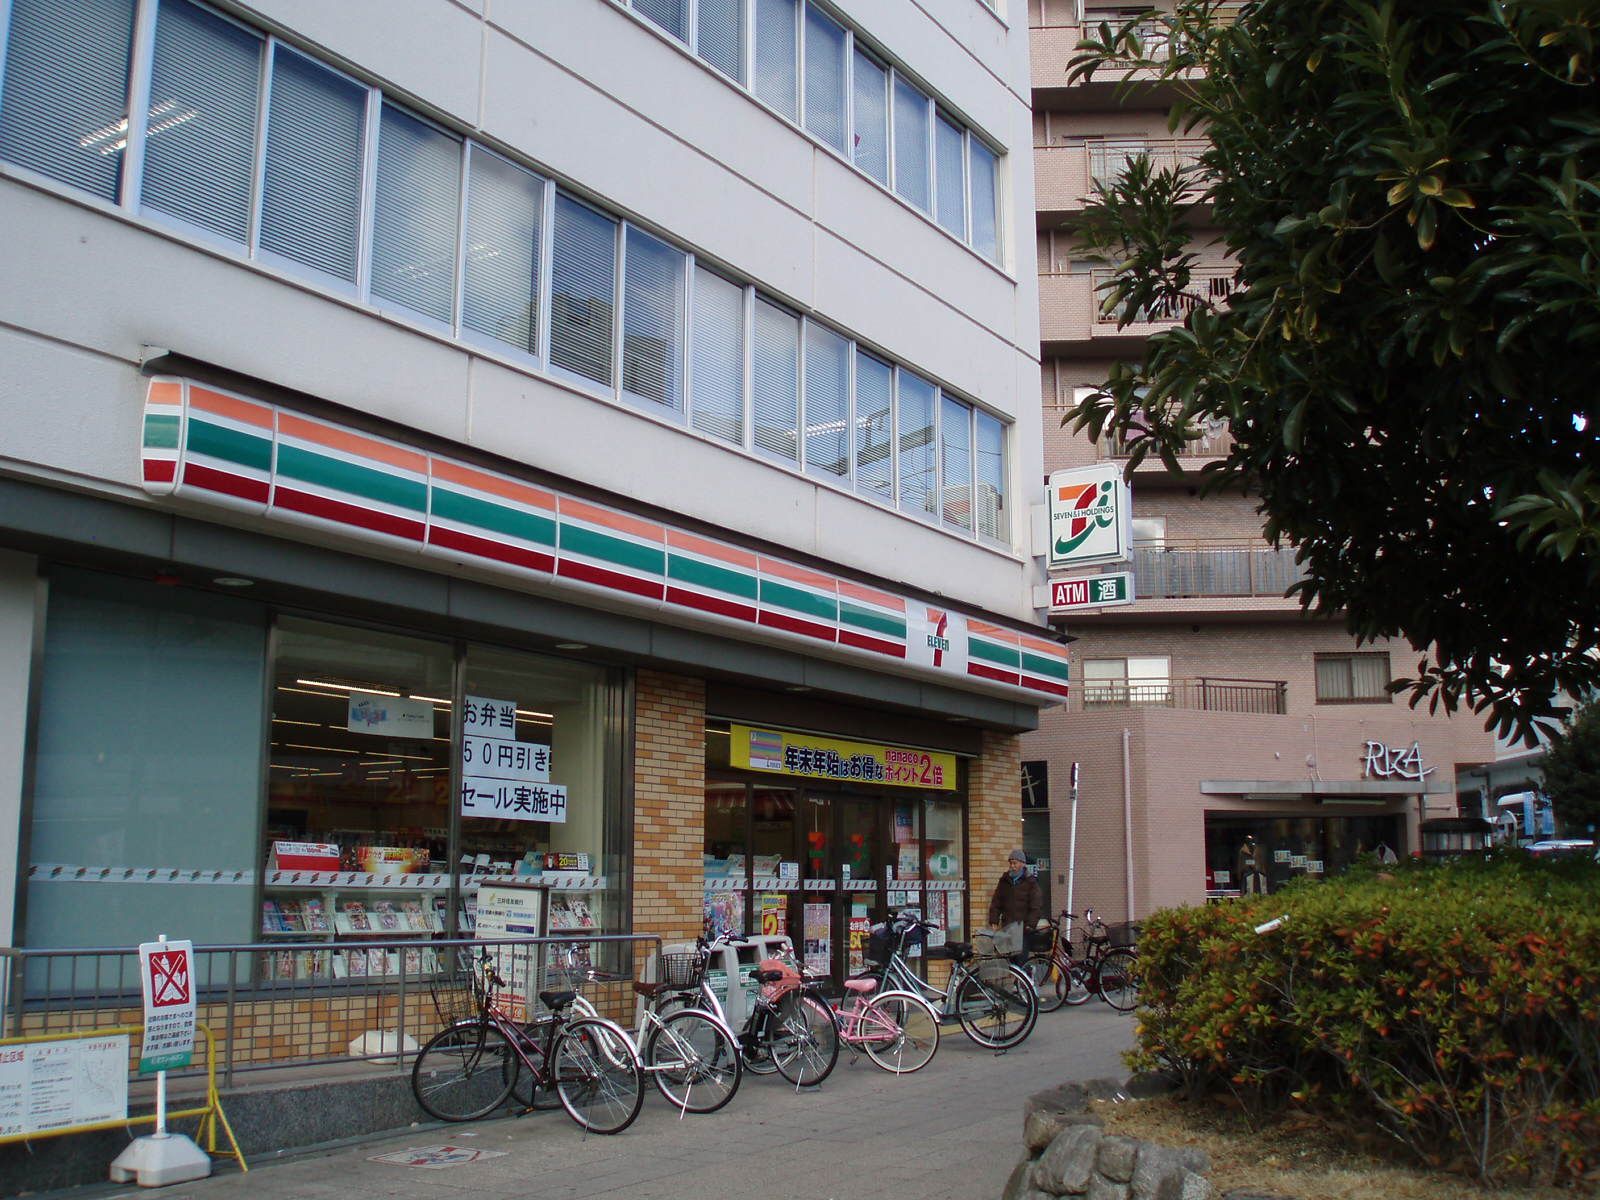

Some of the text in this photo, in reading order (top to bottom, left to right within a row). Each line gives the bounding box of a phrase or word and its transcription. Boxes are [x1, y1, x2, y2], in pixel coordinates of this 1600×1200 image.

[1080, 505, 1114, 517] HOLDINGS
[1056, 583, 1085, 604] ATM
[1098, 579, 1116, 601] 酒
[463, 701, 516, 730] お弁当
[784, 744, 884, 781] 年末年始はお得な
[885, 749, 919, 765] nanaco
[461, 782, 566, 816] セール実施中
